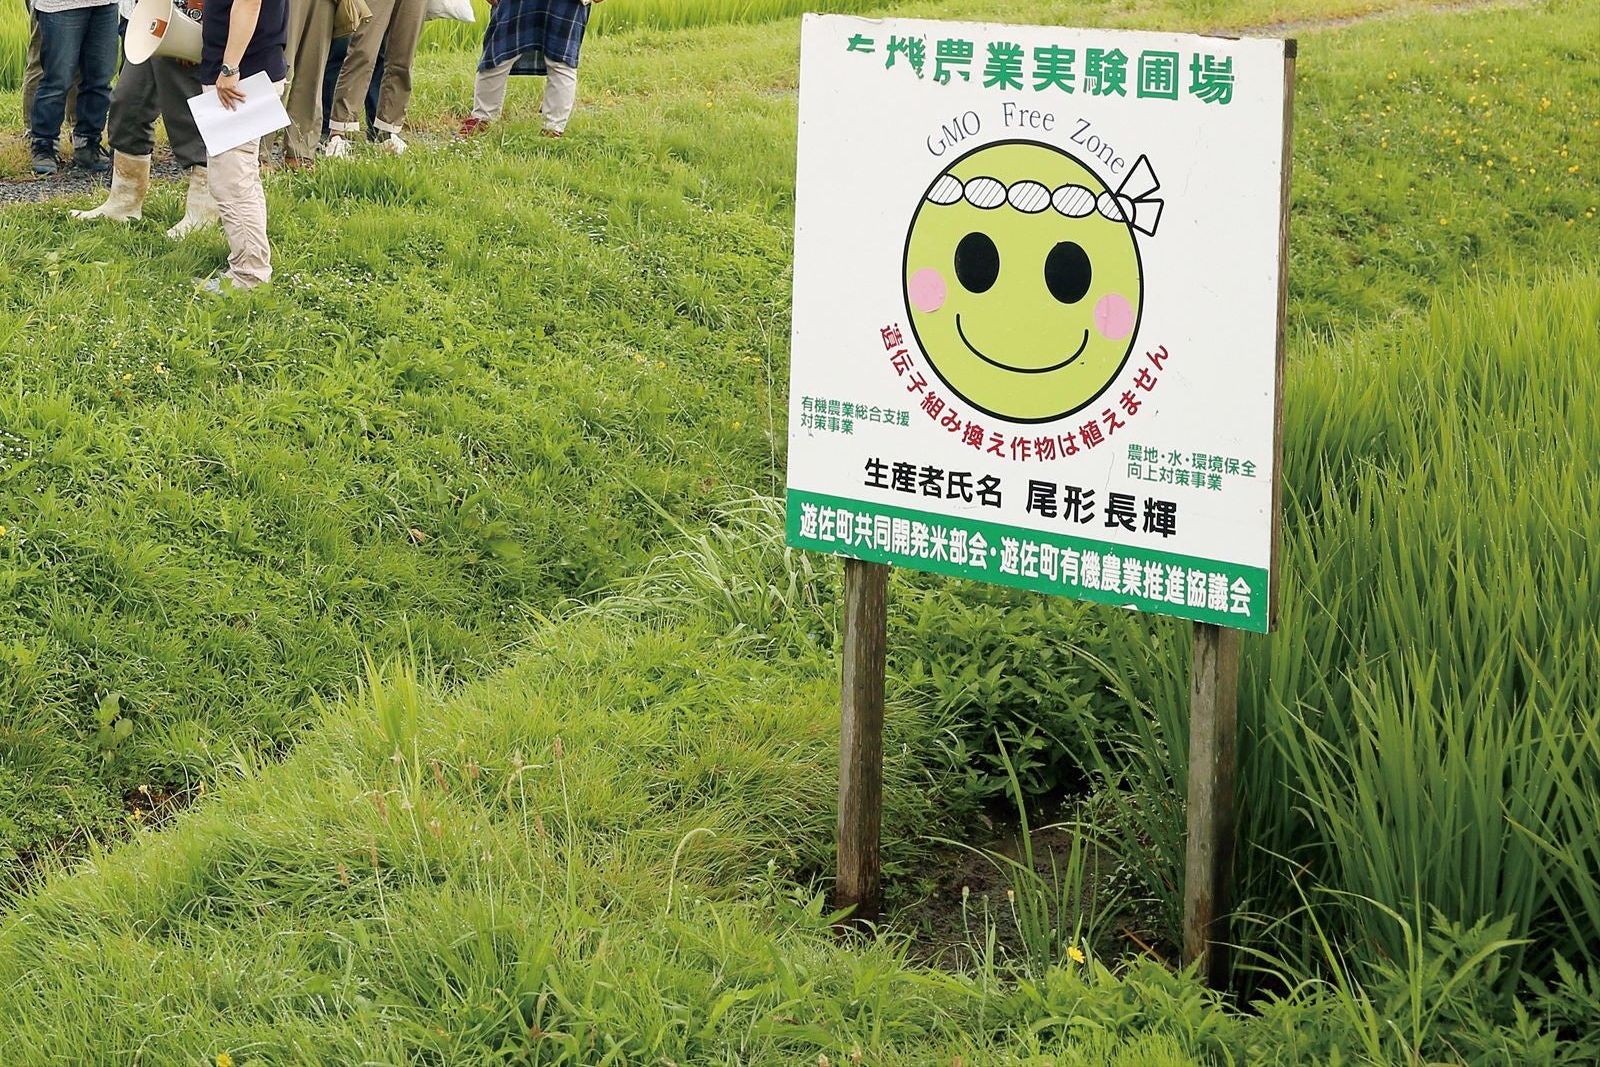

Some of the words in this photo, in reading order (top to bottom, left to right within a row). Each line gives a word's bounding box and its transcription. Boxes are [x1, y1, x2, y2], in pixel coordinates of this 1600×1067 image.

[926, 110, 982, 158] GMO
[1002, 102, 1056, 132] Free
[1069, 118, 1126, 175] Zone
[801, 396, 910, 428] 有機農業総合支援
[880, 322, 1169, 462] 遺伝子組み換え作物は植えません
[800, 412, 854, 435] 対策事業
[864, 457, 1002, 509] 生産者氏名
[1026, 479, 1177, 538] 尾形長輝
[1127, 462, 1223, 491] 向上対策事業
